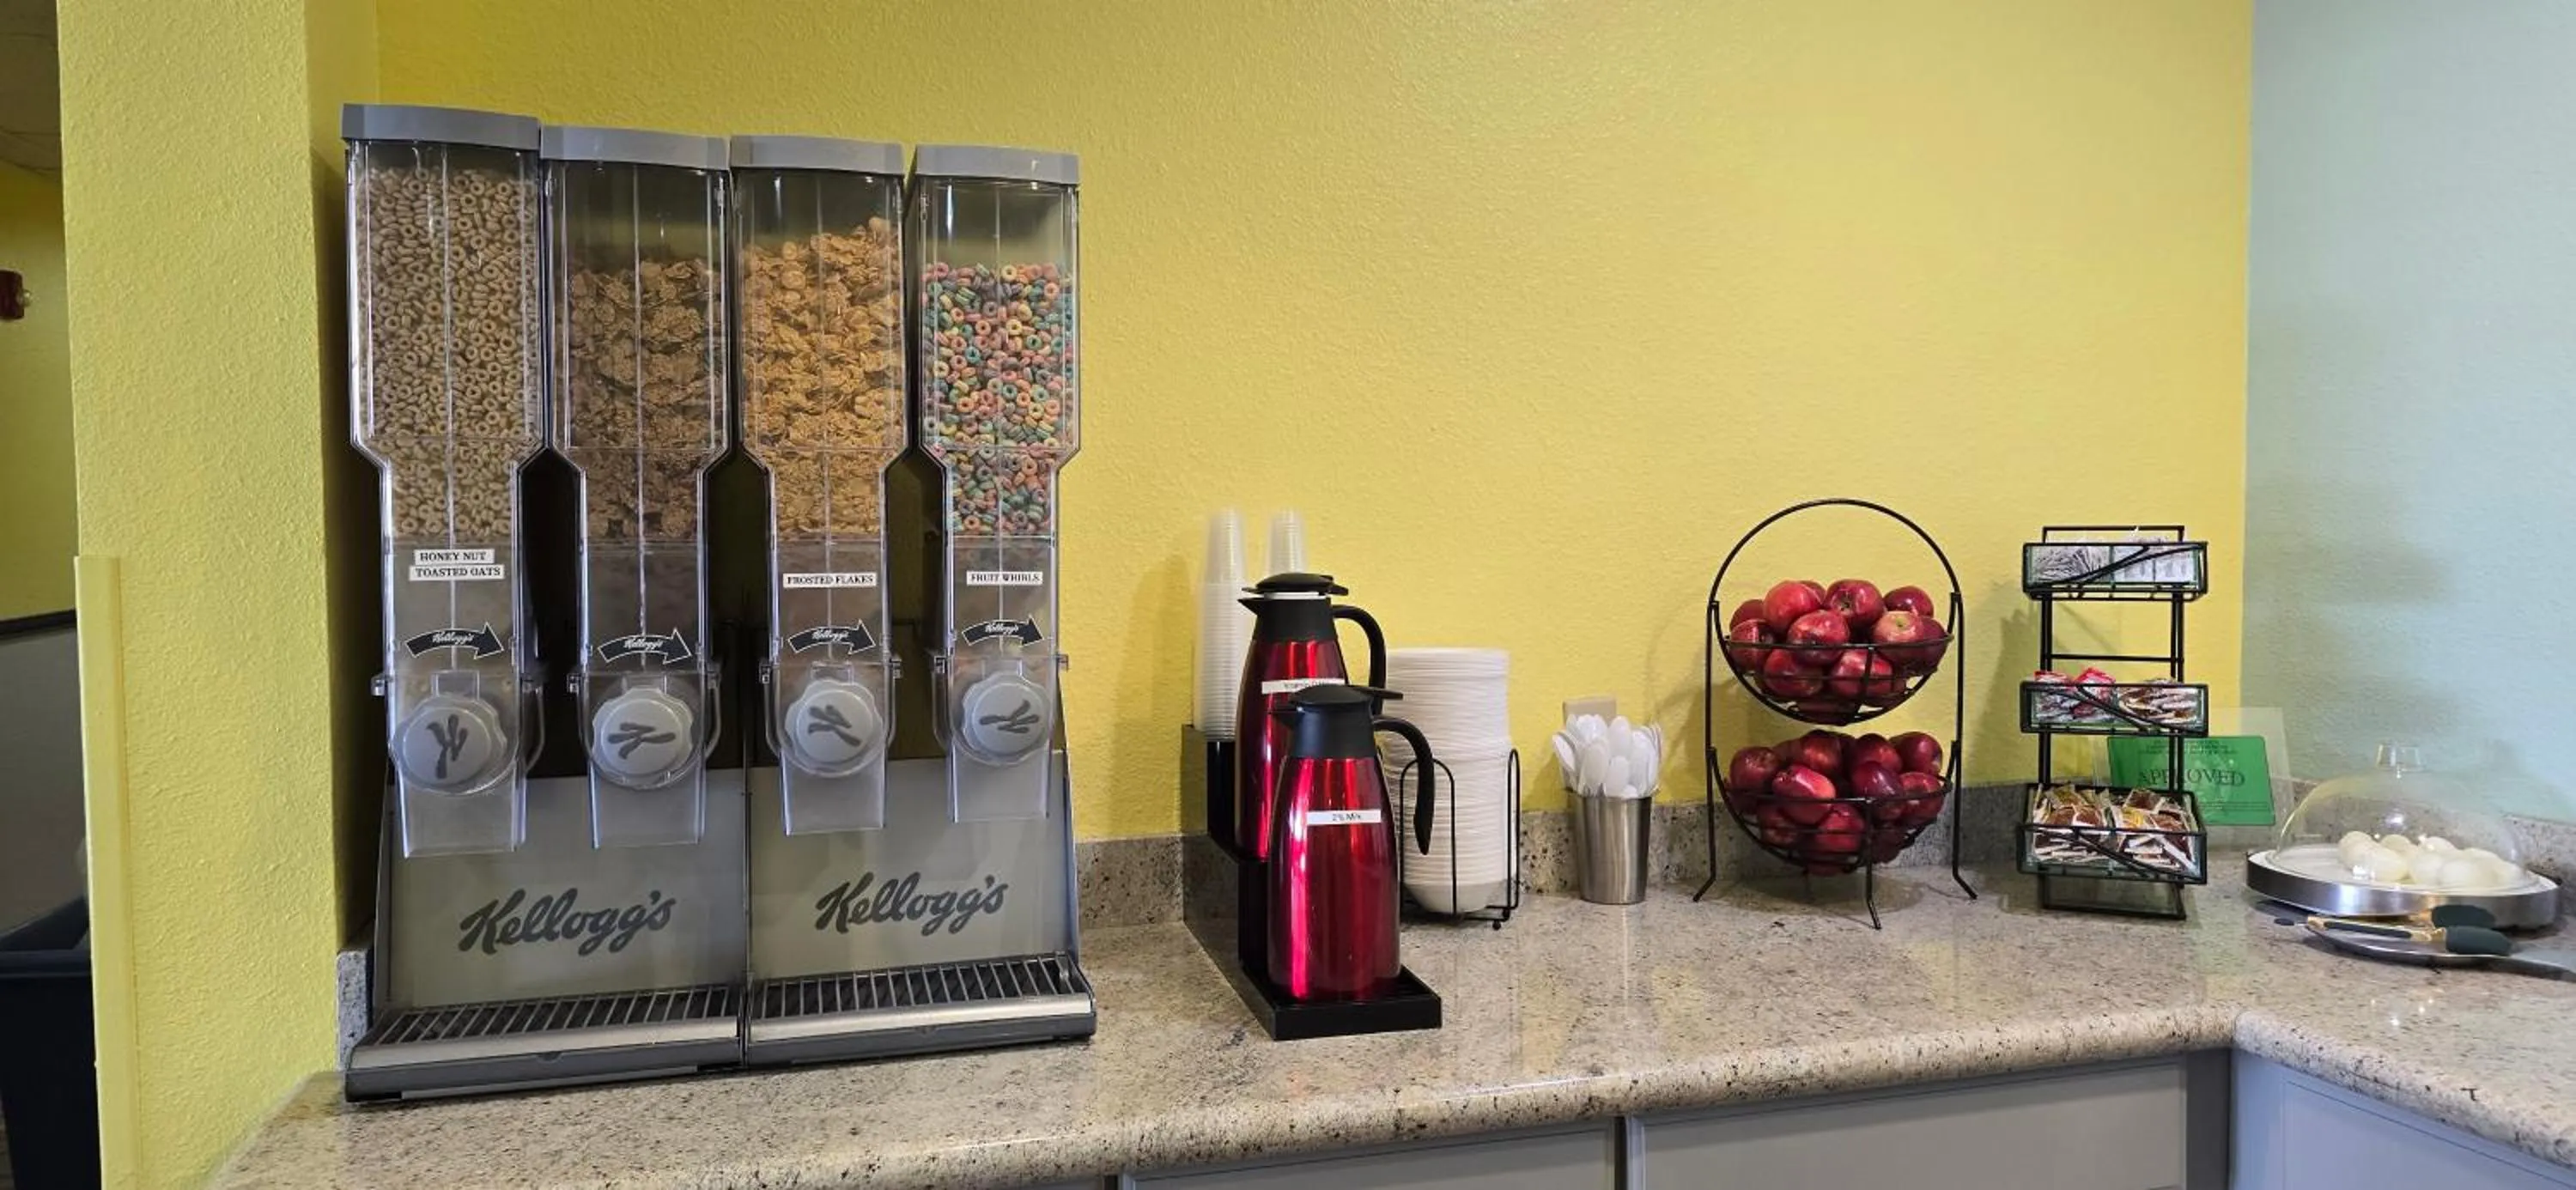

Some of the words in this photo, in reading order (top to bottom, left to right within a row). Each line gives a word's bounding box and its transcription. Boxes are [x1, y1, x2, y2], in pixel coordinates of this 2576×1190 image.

[419, 552, 459, 562] HONEY
[463, 551, 487, 561] NUT
[415, 568, 468, 577] TOASTED
[470, 567, 501, 576] OATS
[971, 573, 999, 582] FRUIT
[1002, 573, 1040, 582] WHIRLS
[787, 576, 834, 585] FROSTED
[835, 574, 873, 584] FLAKES
[984, 622, 1019, 634] Kellogg's
[432, 631, 474, 645] Kellogg's
[811, 628, 849, 642] Kellogg's
[623, 638, 664, 651] Kellogg's
[2137, 768, 2246, 787] APPOVED
[815, 871, 1010, 936] Kellogg's
[458, 887, 677, 956] Kellogg's
